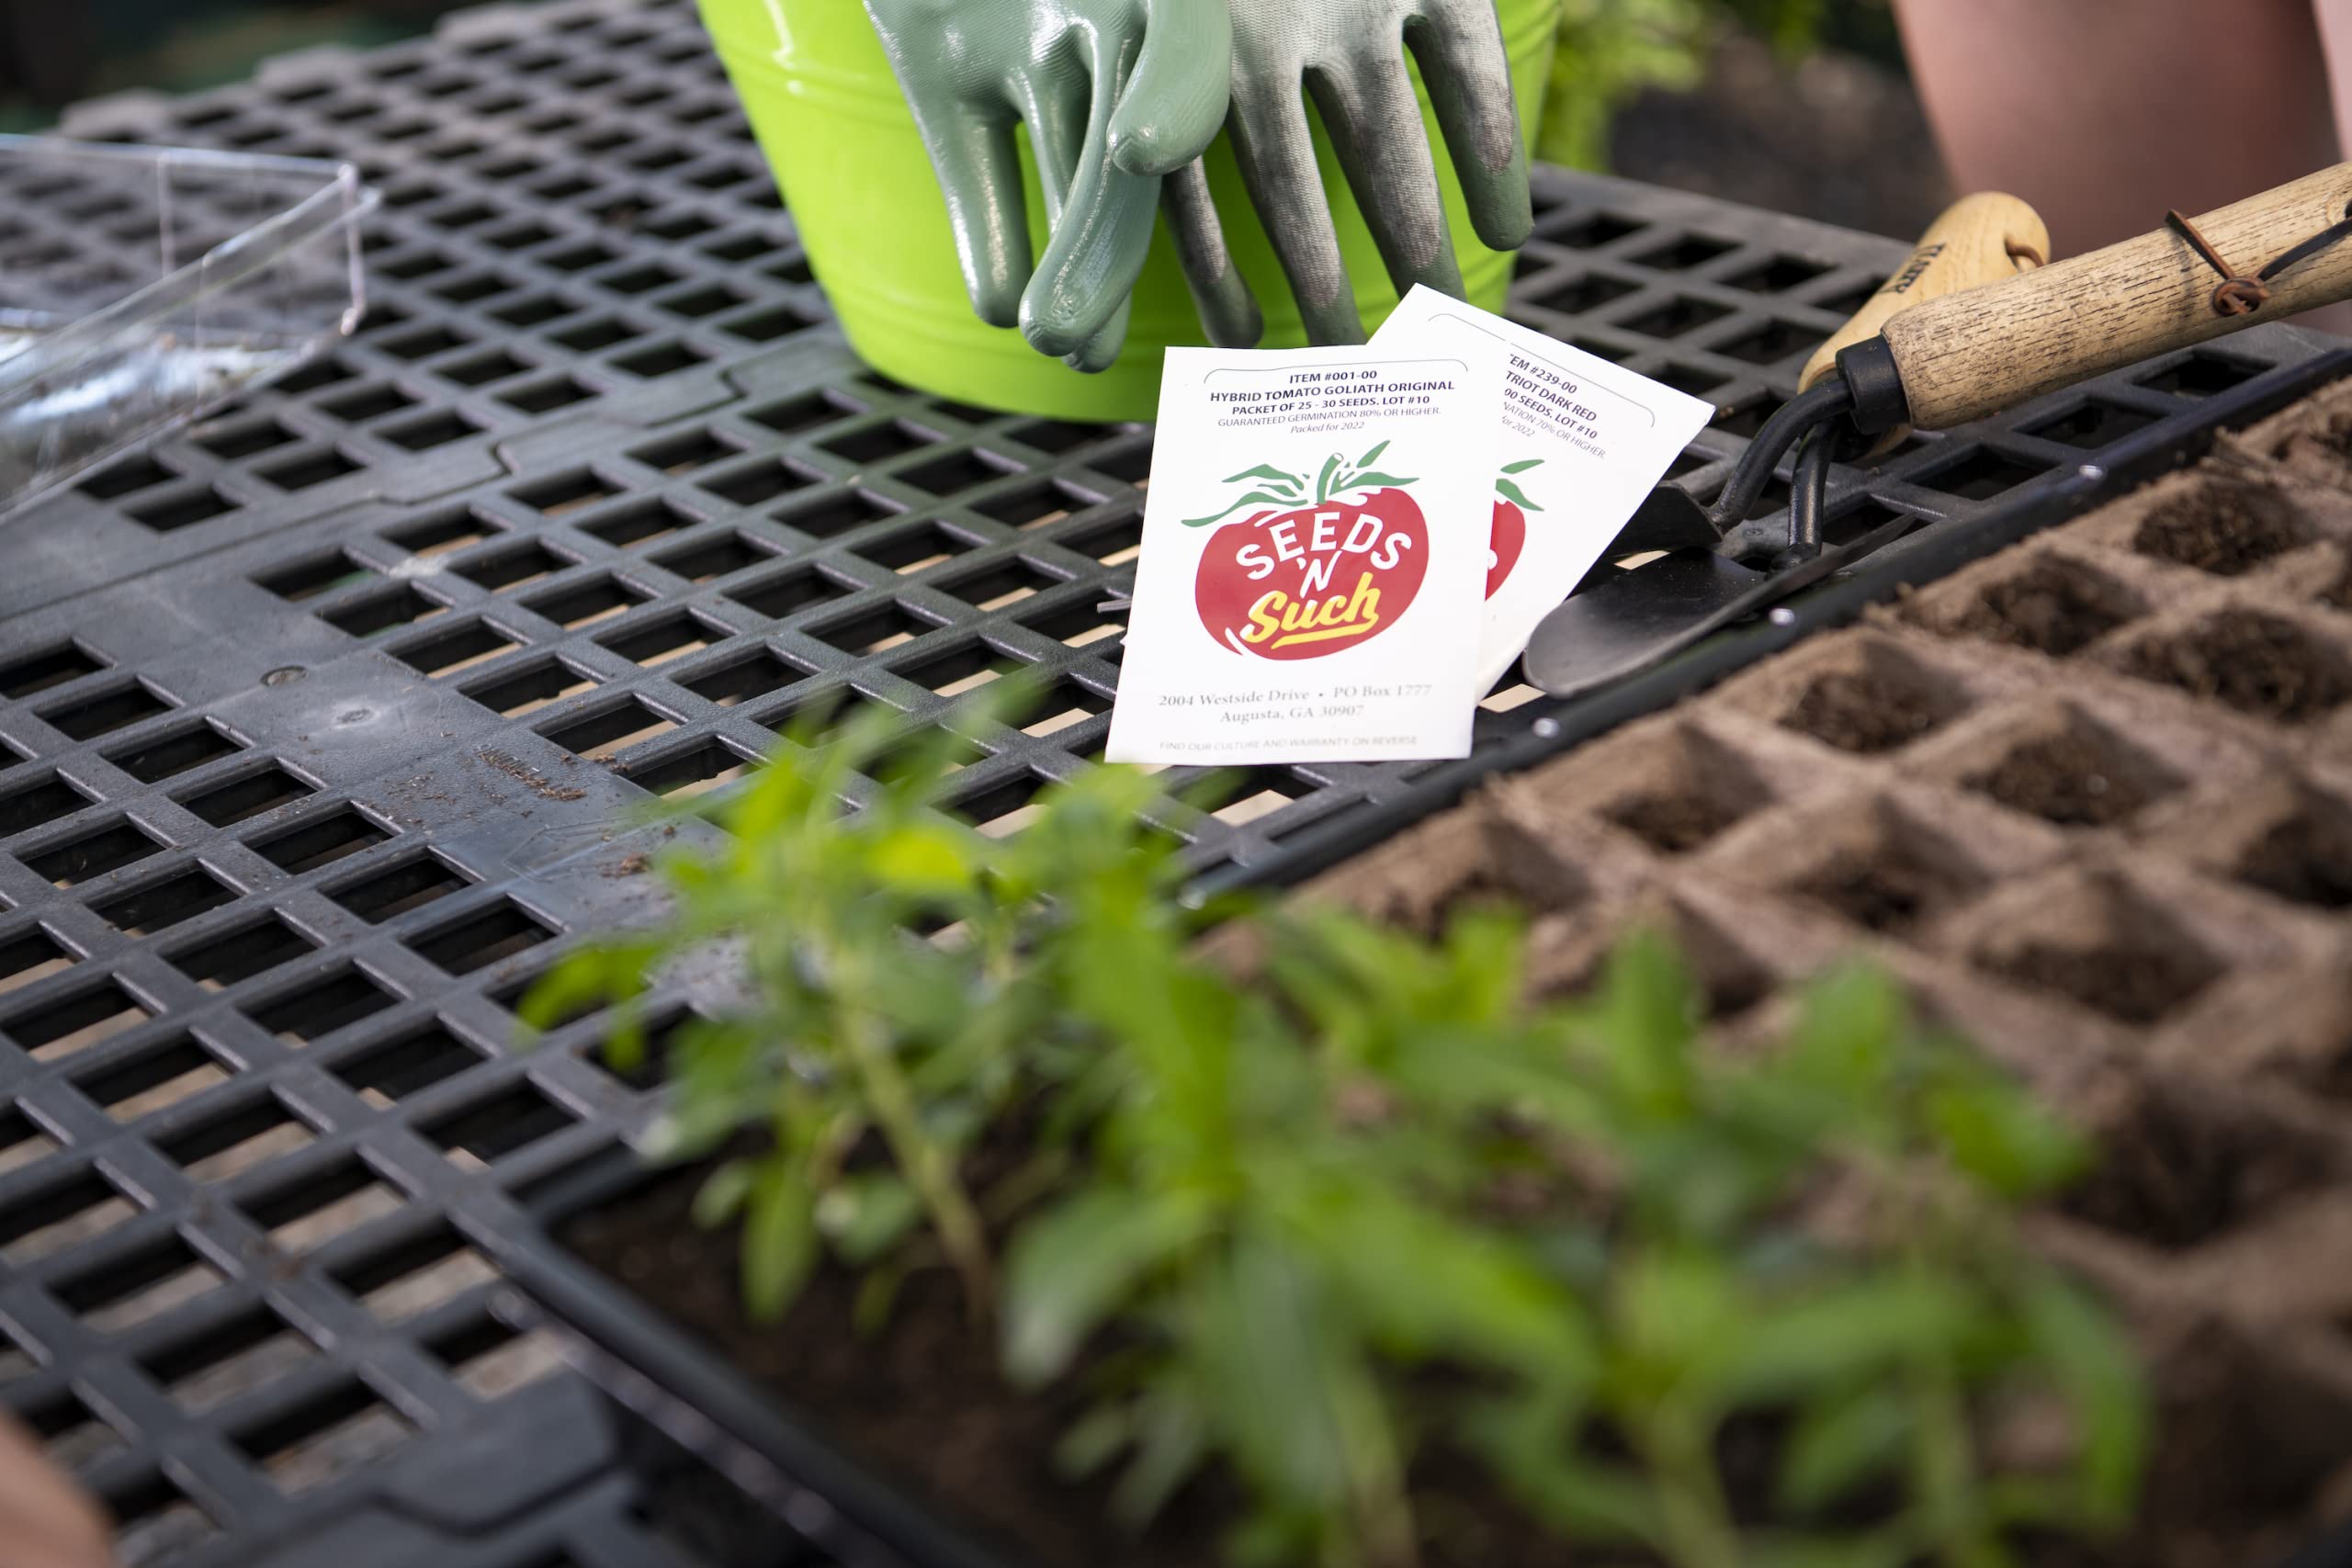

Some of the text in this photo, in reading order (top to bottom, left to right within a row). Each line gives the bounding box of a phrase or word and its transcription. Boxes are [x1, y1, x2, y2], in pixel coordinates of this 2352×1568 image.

[1290, 370, 1377, 384] ITEM #001-00
[1510, 354, 1577, 394] EM #239-00
[1210, 380, 1455, 401] HYBRID TOMATO GOLIATH ORIGINAL
[1506, 370, 1598, 422] TRIOT DARK RED
[1232, 404, 1277, 415] PACKET
[1280, 402, 1295, 412] OF
[1298, 400, 1312, 410] 25
[1321, 400, 1337, 408] 30
[1339, 397, 1380, 407] SEEDS.
[1383, 396, 1406, 405] LOT
[1408, 395, 1430, 404] #10
[1504, 388, 1599, 439] 00 SEEDS. LOT #10
[1217, 406, 1442, 426] GUARANTEED GERMINATION 80% OR HIGHER.
[1290, 421, 1365, 434] Packed for 2022
[1512, 422, 1536, 437] 2022
[1536, 419, 1555, 434] 70%
[1556, 429, 1571, 442] OR
[1236, 511, 1413, 581] SEEDS
[1239, 571, 1382, 649] Such
[1159, 683, 1433, 706] 2004 Westside Drive PO Box 1777
[1220, 704, 1364, 725] Augusta, GA 30907
[1159, 741, 1185, 750] FIND
[1188, 741, 1212, 750] OUR
[1214, 740, 1260, 751] CULTURE
[1263, 739, 1287, 749] AND
